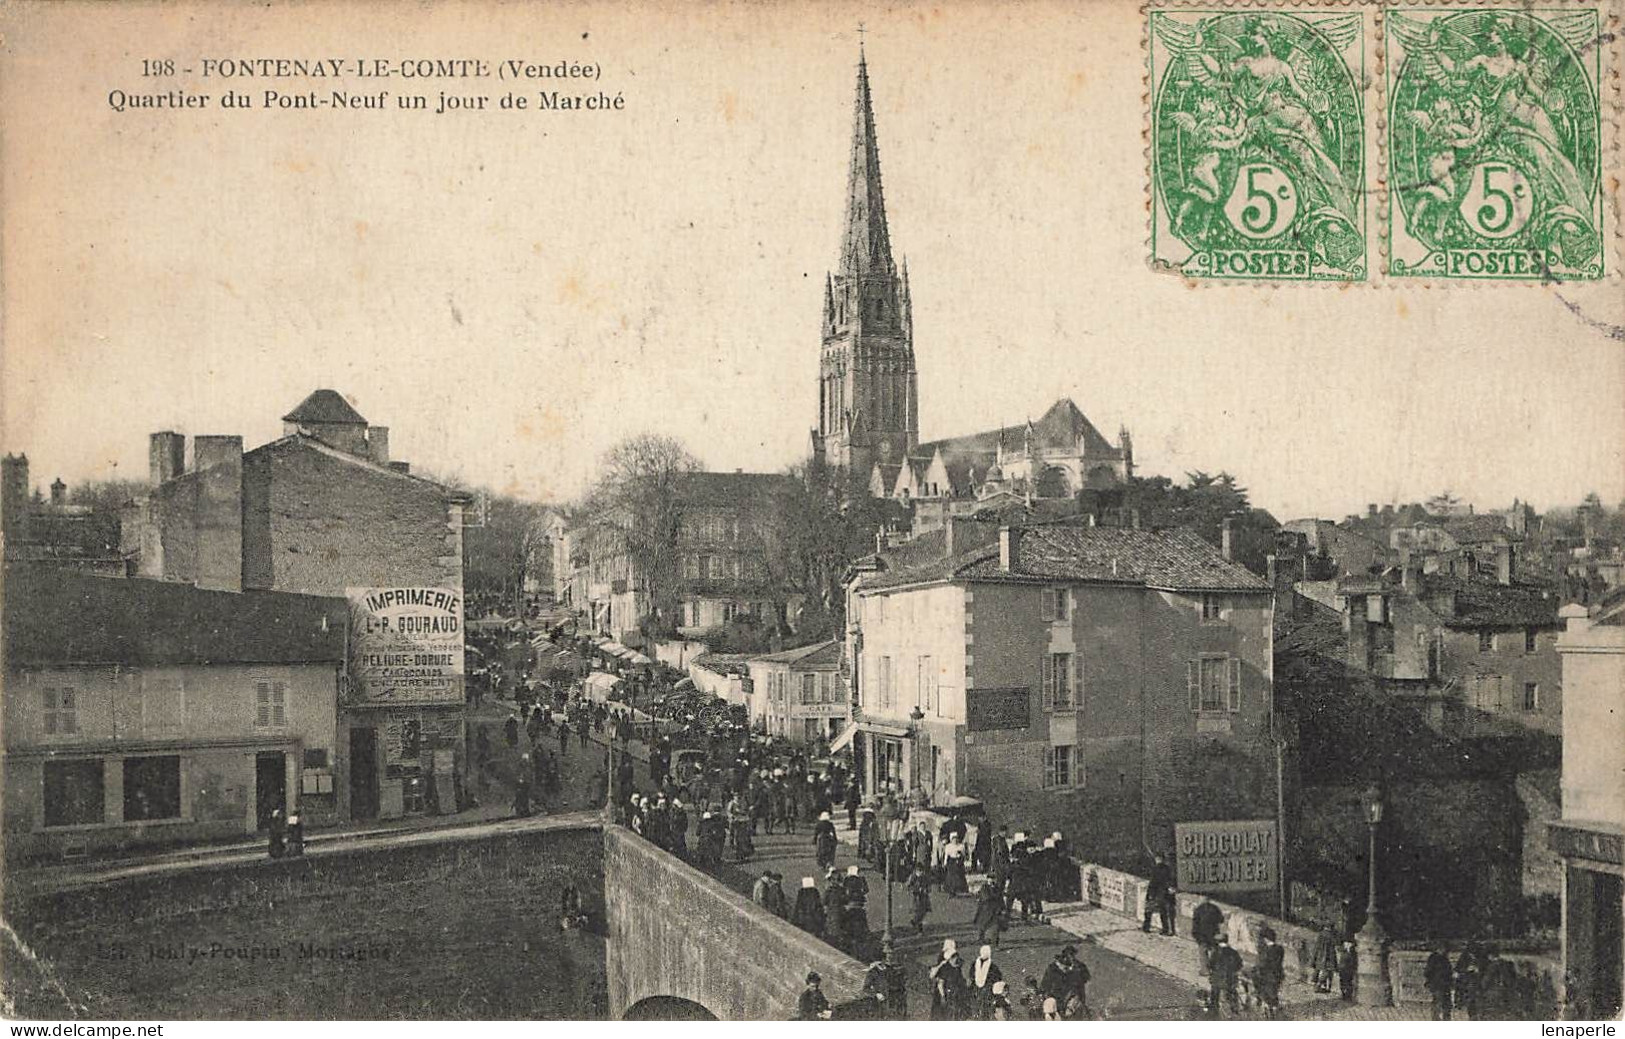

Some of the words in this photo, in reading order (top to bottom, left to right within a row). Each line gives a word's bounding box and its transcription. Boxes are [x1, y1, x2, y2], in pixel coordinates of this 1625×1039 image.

[1214, 252, 1307, 275] POSTES
[1450, 251, 1543, 275] POSTES
[366, 589, 460, 614] IMPRIMERIE
[398, 616, 458, 633] GOURAUD
[363, 654, 454, 667] RELIURE-DORURE
[1182, 831, 1272, 857] CHOCOLAT
[1184, 858, 1269, 884] MENIER
